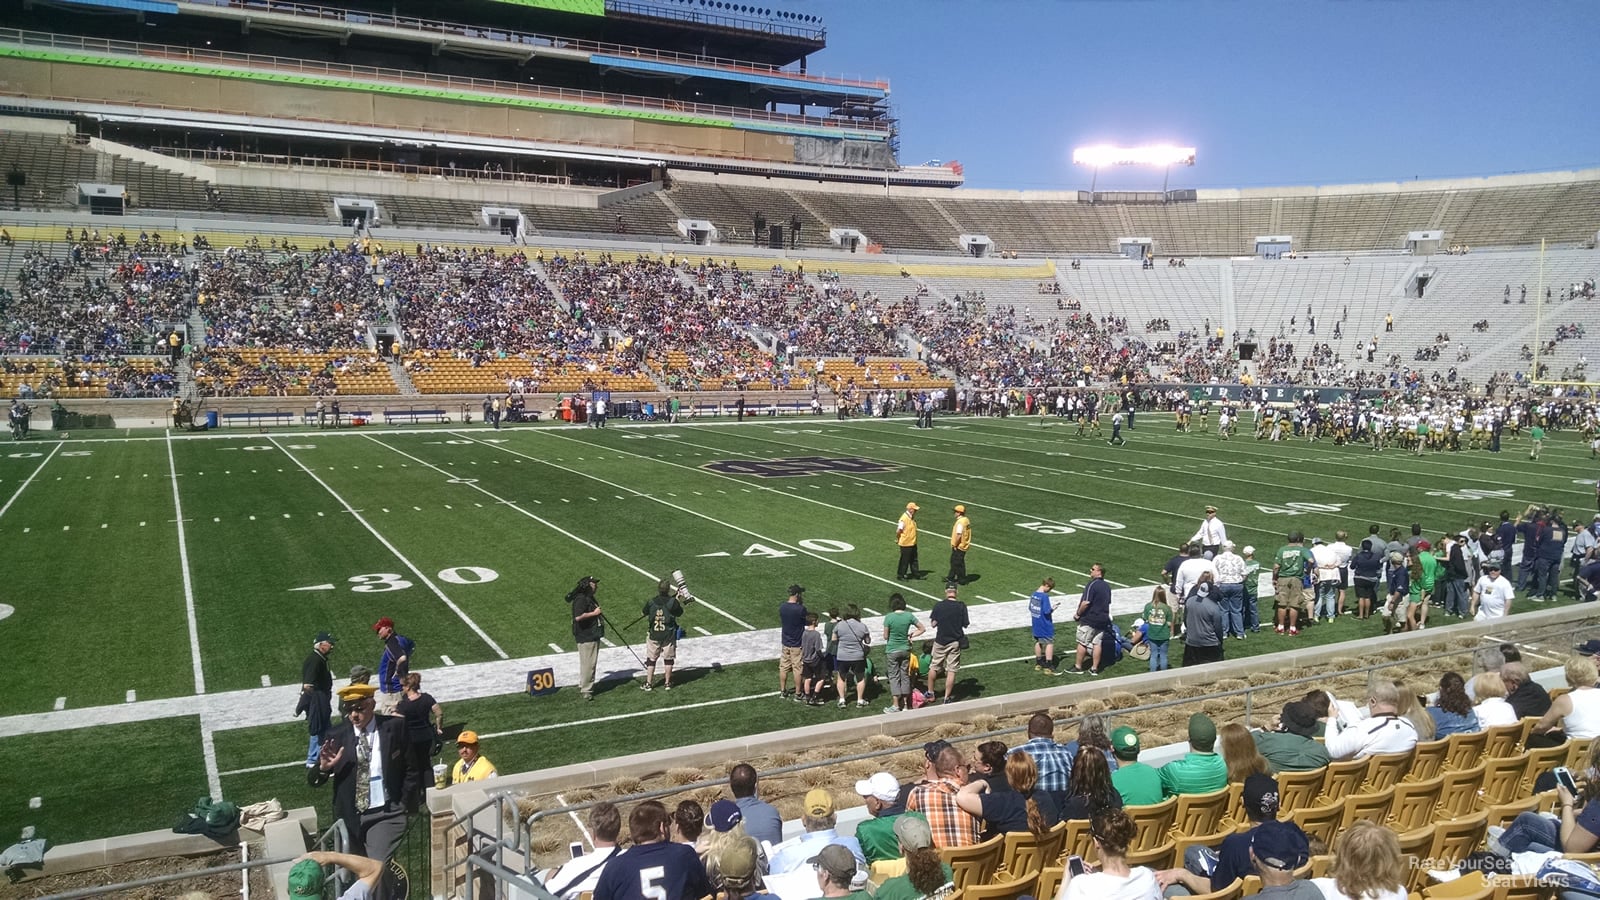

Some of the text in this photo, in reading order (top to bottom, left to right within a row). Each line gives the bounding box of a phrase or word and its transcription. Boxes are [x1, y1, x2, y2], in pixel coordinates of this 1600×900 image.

[1014, 518, 1127, 534] 50
[743, 539, 856, 558] 40
[532, 672, 554, 691] 30
[639, 865, 667, 900] 5
